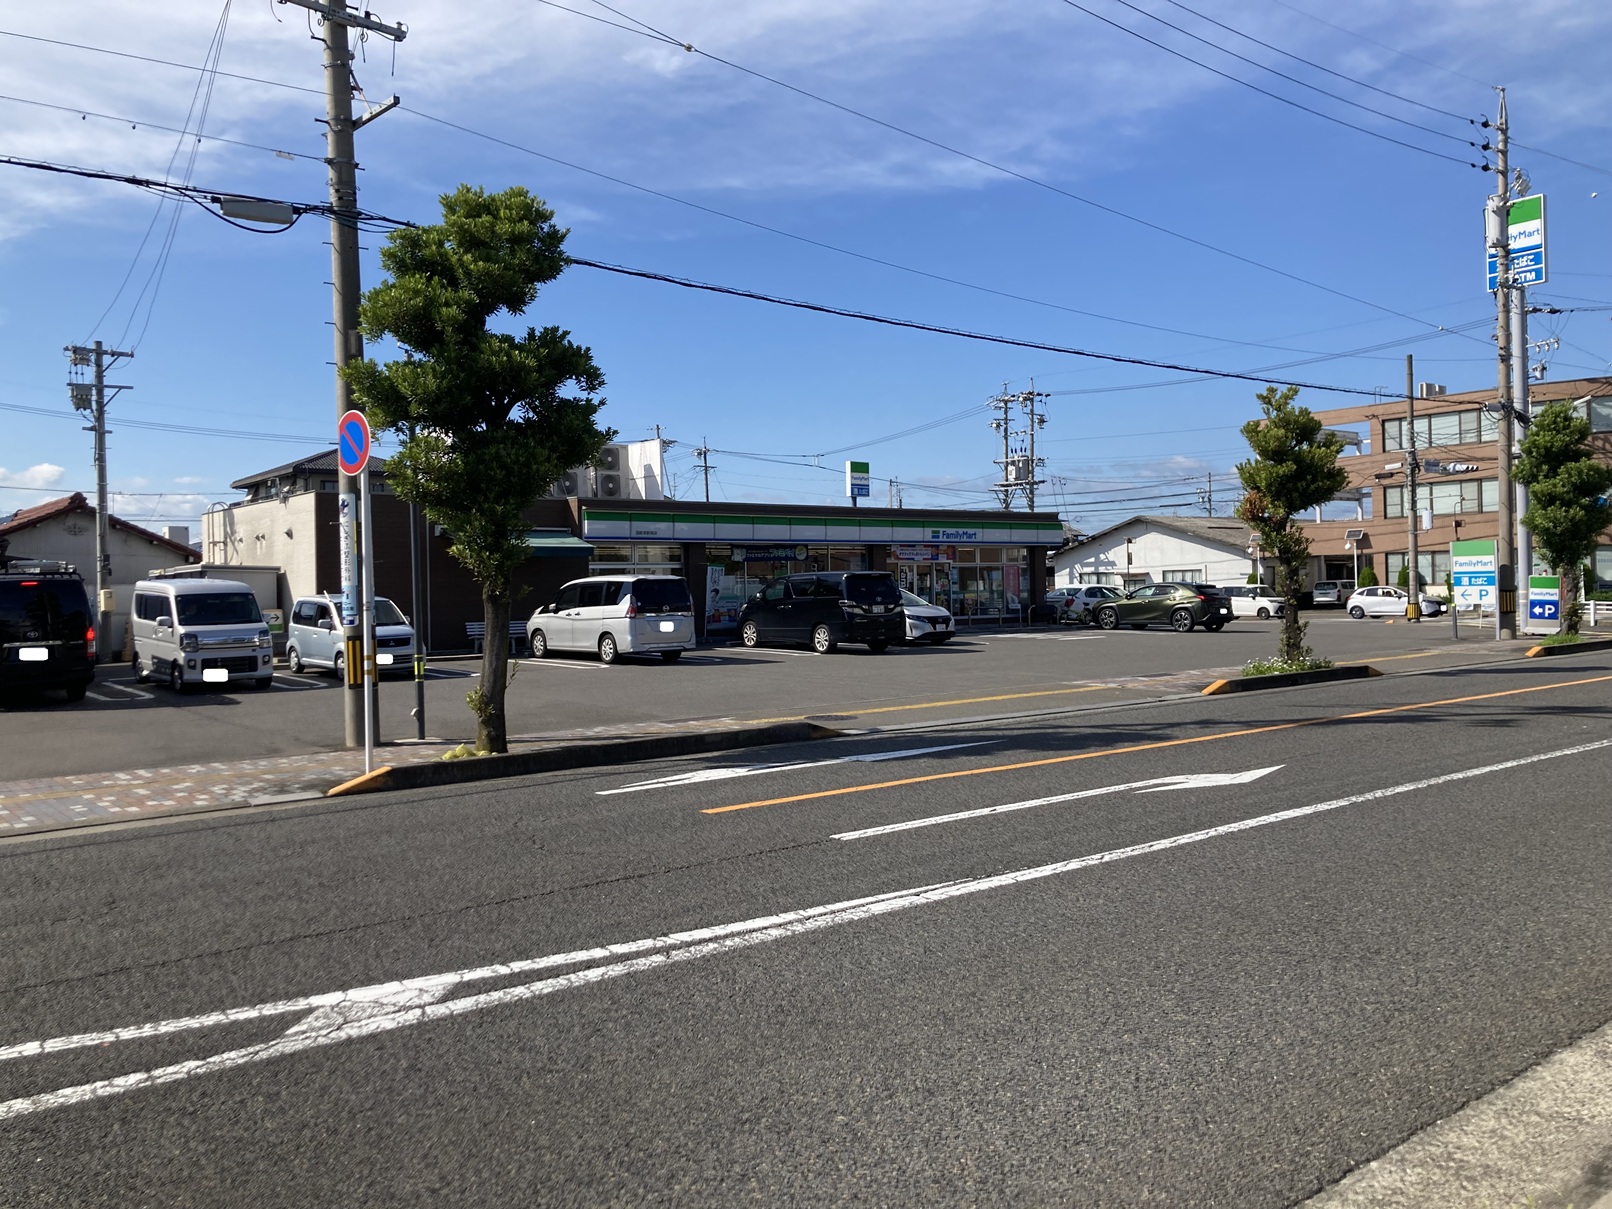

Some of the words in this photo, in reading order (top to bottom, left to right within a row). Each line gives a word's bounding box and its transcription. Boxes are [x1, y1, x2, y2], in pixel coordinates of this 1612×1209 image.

[1509, 228, 1540, 243] lyMart
[942, 530, 977, 541] FamilyMart
[1479, 589, 1489, 601] P
[1545, 604, 1556, 617] P
